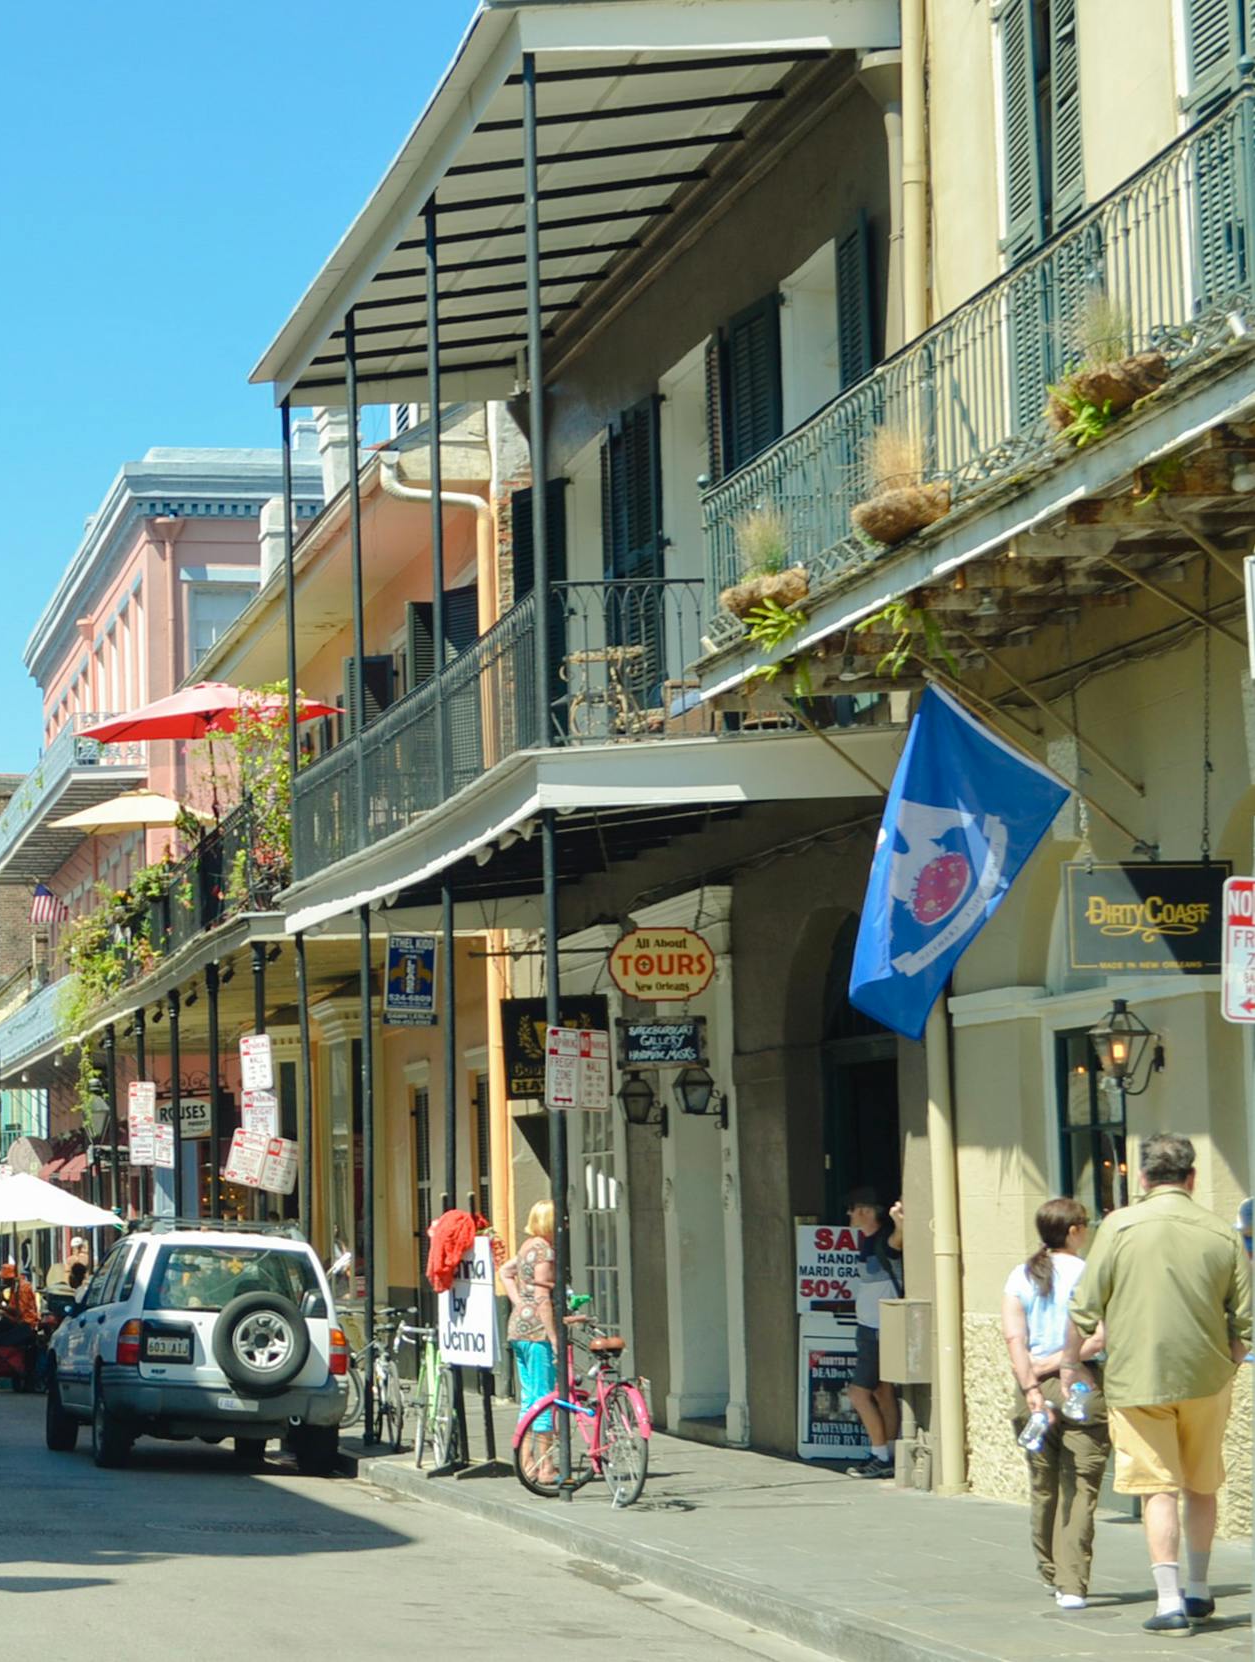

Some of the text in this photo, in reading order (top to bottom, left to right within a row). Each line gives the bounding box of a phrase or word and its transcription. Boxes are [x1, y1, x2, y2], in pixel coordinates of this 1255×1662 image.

[635, 937, 687, 949] All About
[617, 953, 707, 977] TOURS
[1099, 961, 1203, 970] MADE IN NEW ORLEANS
[635, 981, 690, 992] New Orleans
[798, 1265, 835, 1278] MARDI
[800, 1279, 853, 1299] 50%
[453, 1286, 467, 1318] by
[443, 1319, 486, 1353] Jenna
